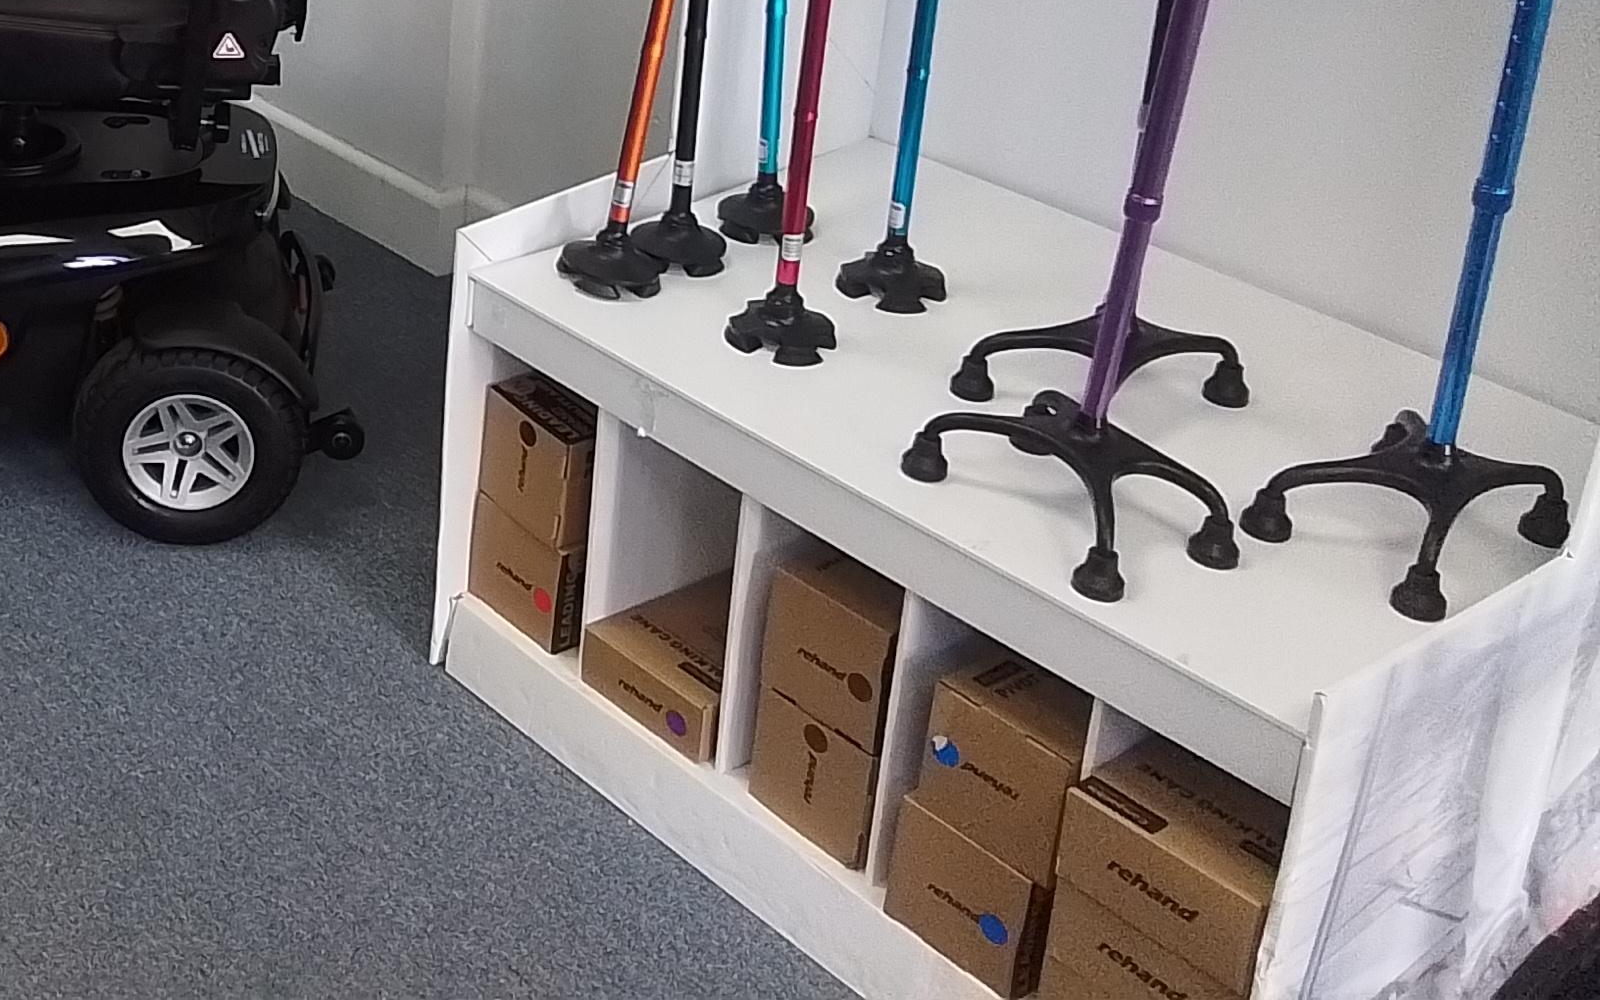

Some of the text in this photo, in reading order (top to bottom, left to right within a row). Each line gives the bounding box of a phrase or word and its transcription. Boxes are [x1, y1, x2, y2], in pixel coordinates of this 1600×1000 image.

[797, 647, 847, 682] rehand
[618, 677, 663, 714] rehand
[1106, 860, 1199, 923] rehand
[1098, 942, 1188, 1000] rehand
